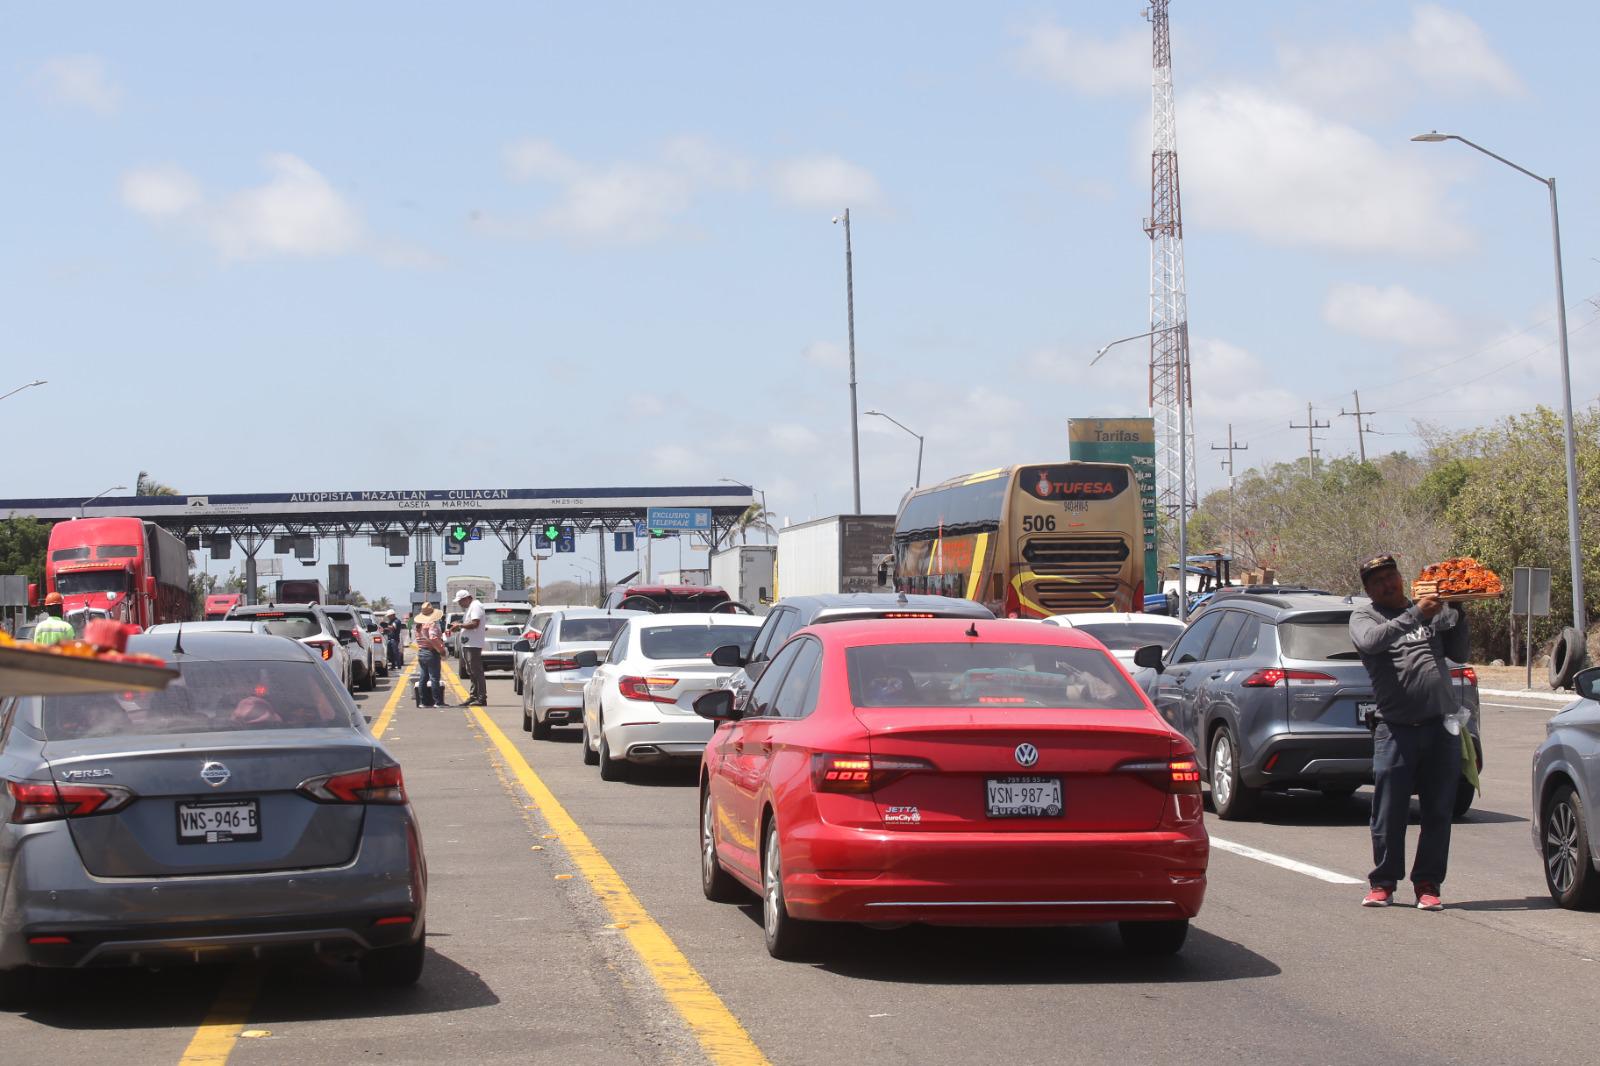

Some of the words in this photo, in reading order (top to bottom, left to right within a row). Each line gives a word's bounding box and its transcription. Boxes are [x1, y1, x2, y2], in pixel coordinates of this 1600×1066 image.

[1094, 430, 1140, 442] Tarifas
[1053, 482, 1114, 494] TUFESA
[290, 491, 354, 502] AUTOPISTA
[361, 490, 426, 501] MAZATLAN
[398, 501, 430, 509] CASETA
[441, 500, 482, 508] MARMOL
[652, 511, 690, 519] EXCLUSIVO
[1022, 514, 1056, 532] 506
[62, 768, 113, 780] VERSA
[989, 787, 1060, 804] VSN-987-A
[992, 805, 1043, 817] EuroCity
[181, 809, 257, 831] VNS-946-B
[885, 813, 911, 823] EuroCity
